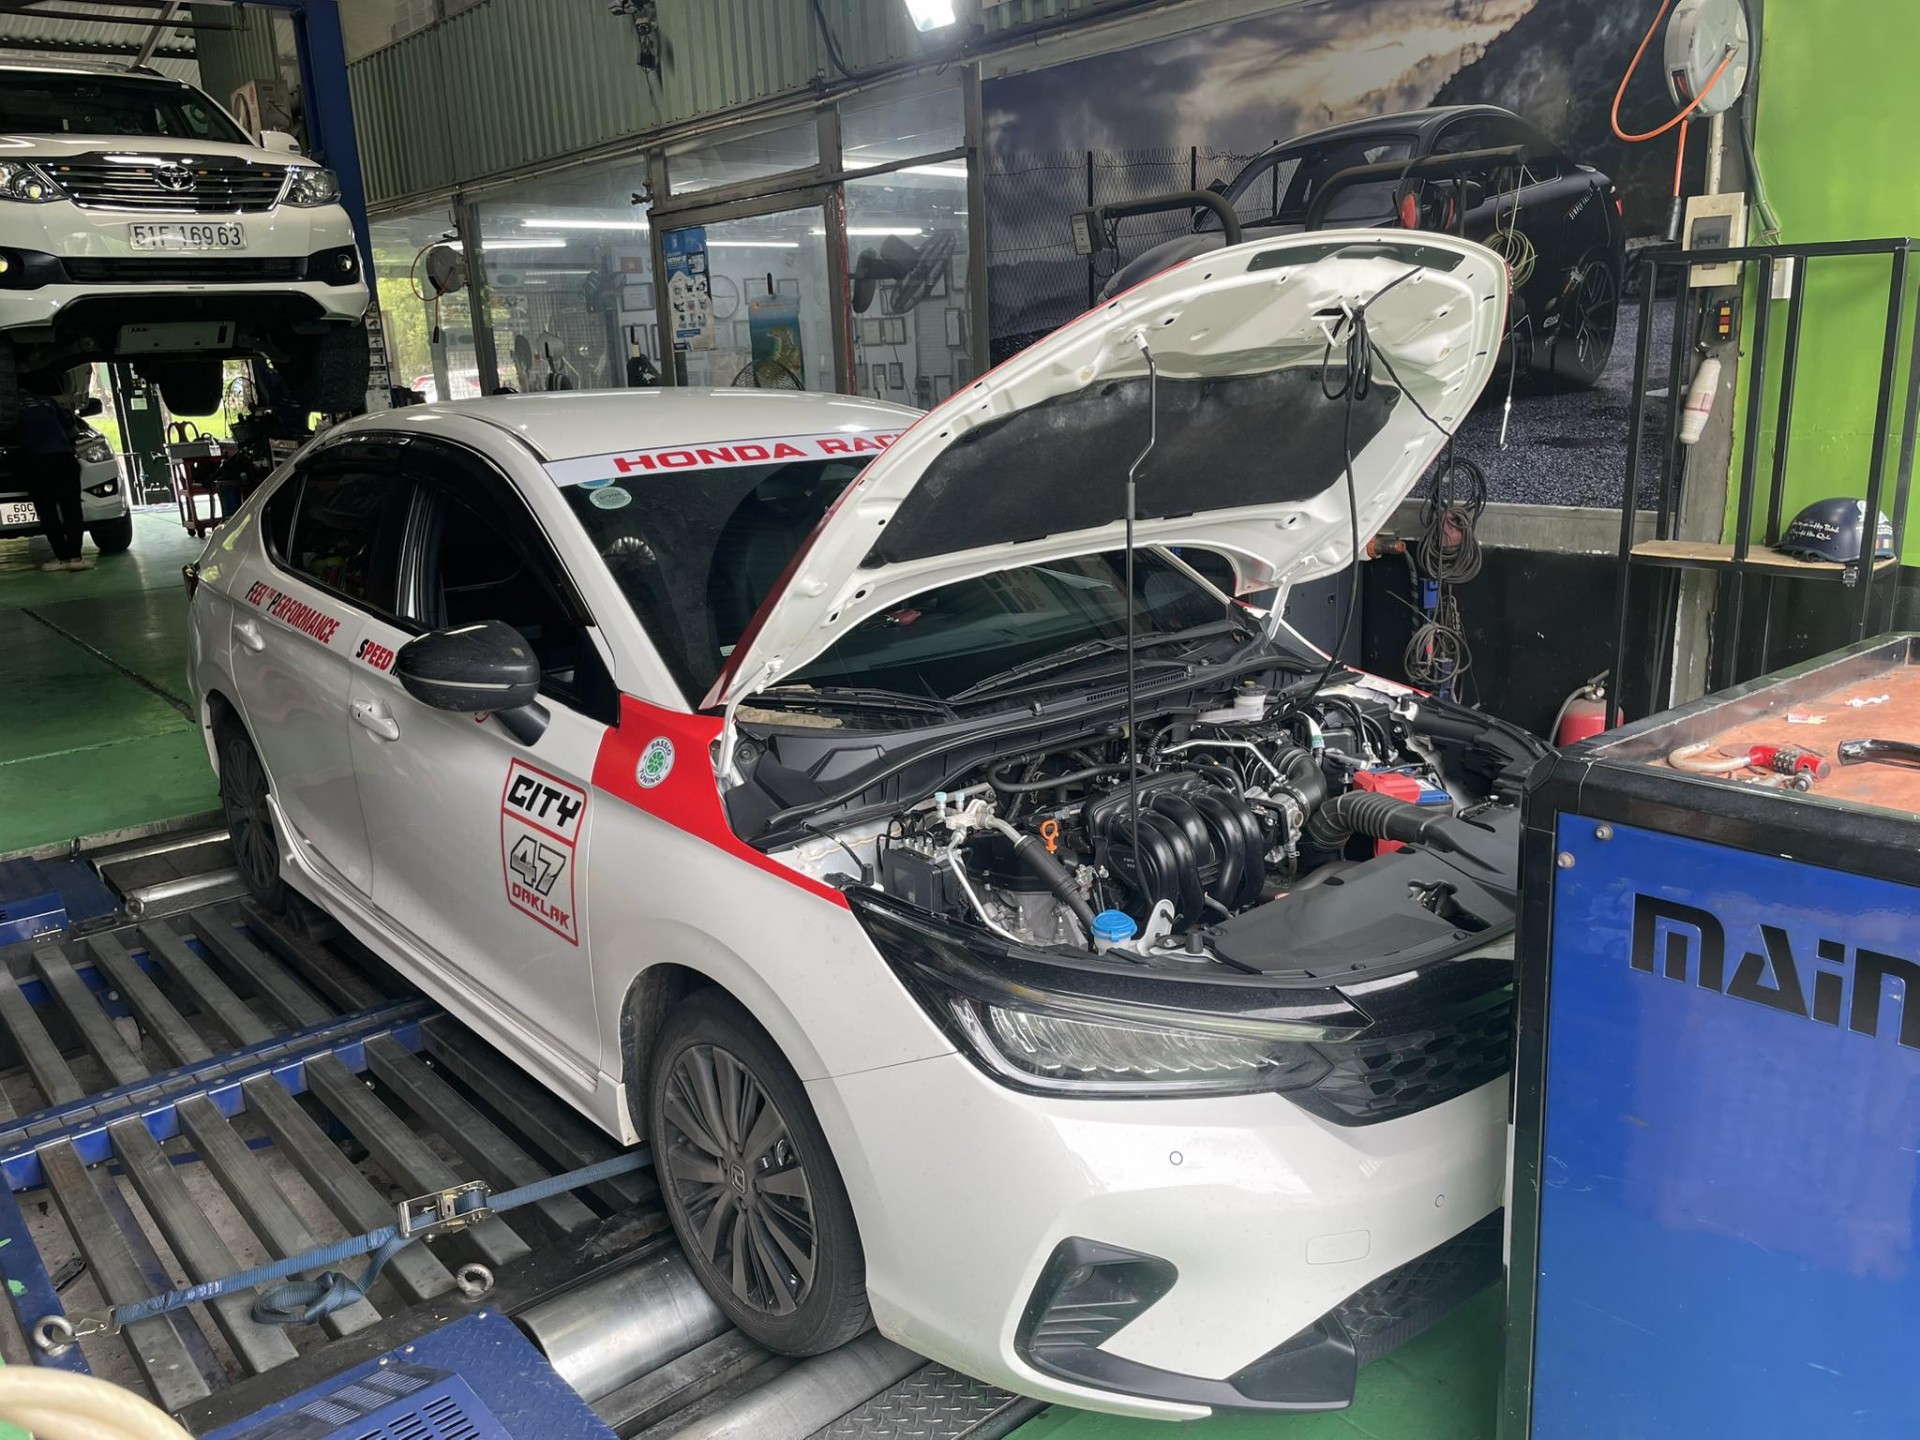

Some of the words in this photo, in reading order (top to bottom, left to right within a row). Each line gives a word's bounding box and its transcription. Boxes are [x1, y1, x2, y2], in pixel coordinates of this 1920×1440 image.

[179, 226, 241, 246] 169.63
[613, 442, 808, 473] HONDA
[815, 434, 899, 455] RAC
[6, 512, 37, 523] 653.7
[13, 503, 34, 513] 60C
[245, 580, 269, 606] FEEL
[266, 592, 341, 644] PERFORMANCE
[355, 638, 395, 671] SPEED
[507, 774, 582, 827] CITY
[510, 834, 567, 897] 47
